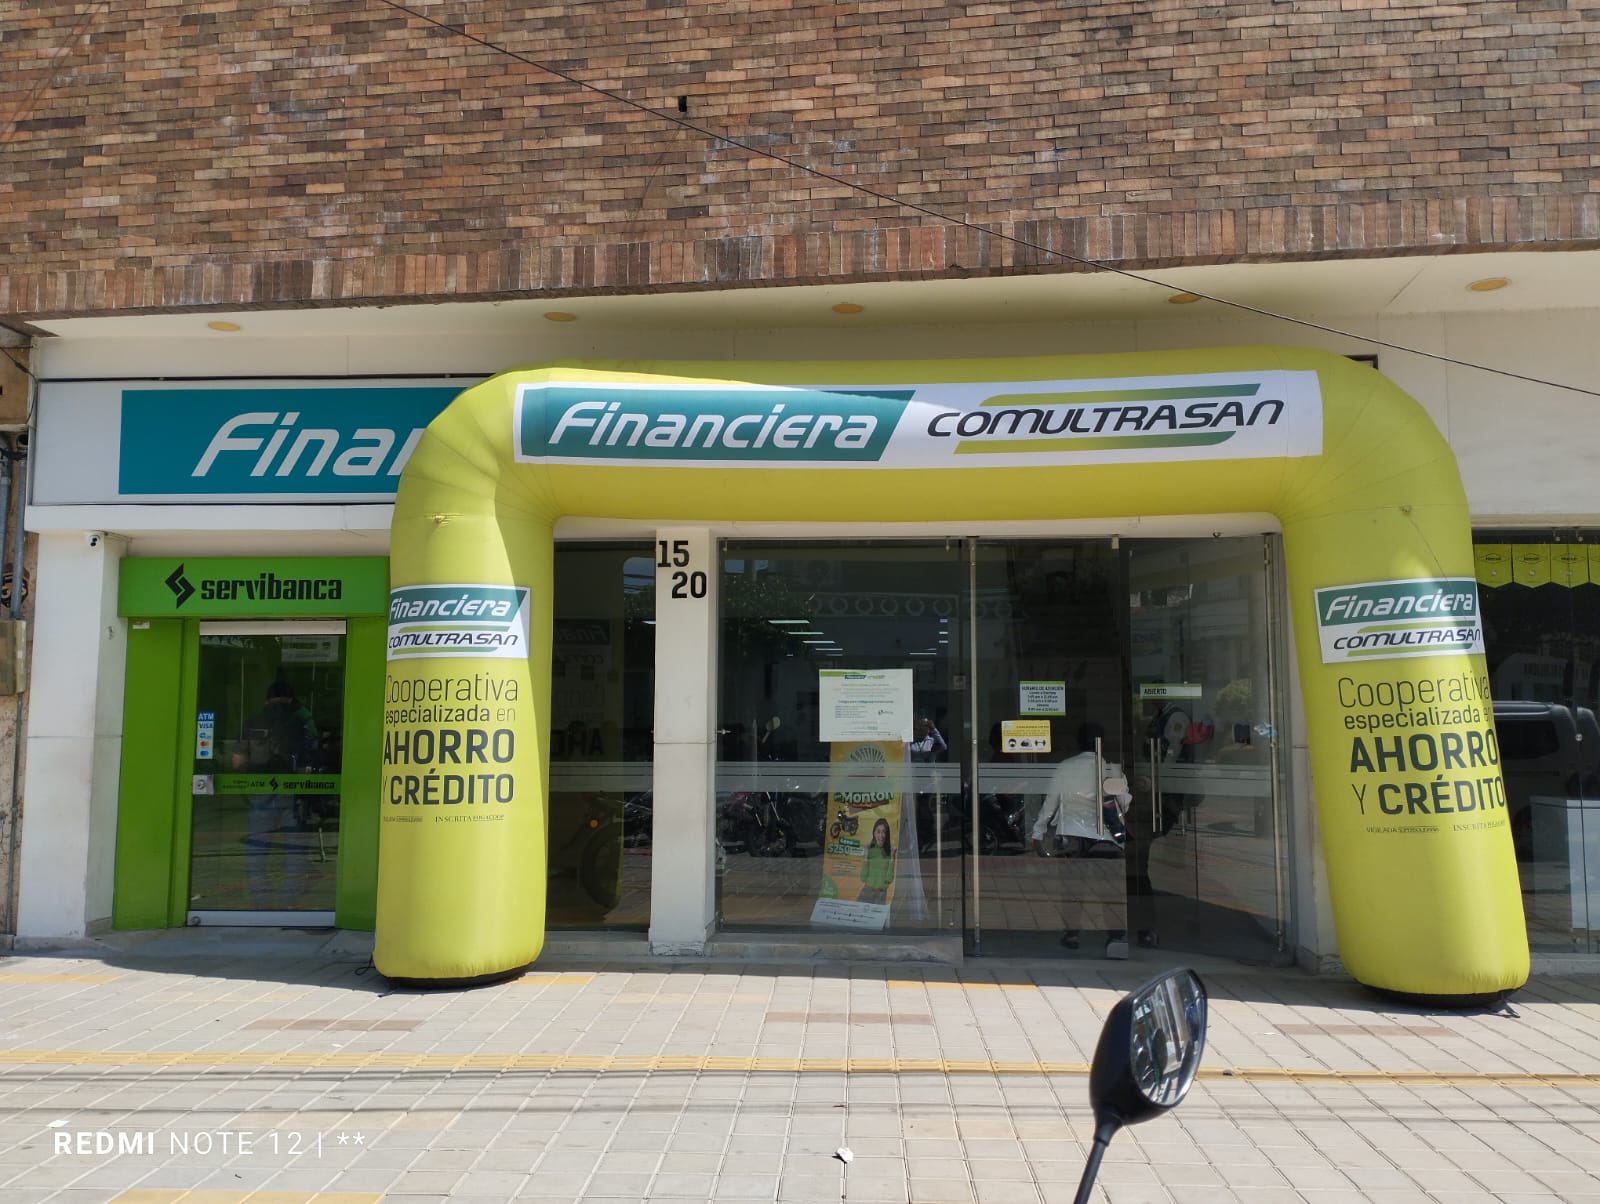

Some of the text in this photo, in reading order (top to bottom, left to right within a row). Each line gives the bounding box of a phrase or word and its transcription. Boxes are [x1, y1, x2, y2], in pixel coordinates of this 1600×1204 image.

[548, 400, 1284, 449] Financiera COMULTRASAN
[657, 540, 690, 568] 15
[201, 573, 342, 601] servibanca
[672, 571, 707, 599] 20
[389, 594, 511, 620] Financiera
[1325, 588, 1473, 621] Financiera
[388, 632, 518, 649] COMULTRASAN
[1333, 628, 1481, 650] COMULTRASAN
[386, 672, 518, 707] Cooperativa
[1338, 670, 1490, 711] Cooperativa
[198, 712, 214, 720] ATM
[386, 704, 516, 727] especializada en
[1344, 704, 1480, 733] especializada
[384, 729, 515, 765] AHORRO
[1350, 728, 1498, 773] AHORRO
[390, 768, 514, 805] CRÉDITO
[1351, 774, 1505, 815] Y CRÉDITO
